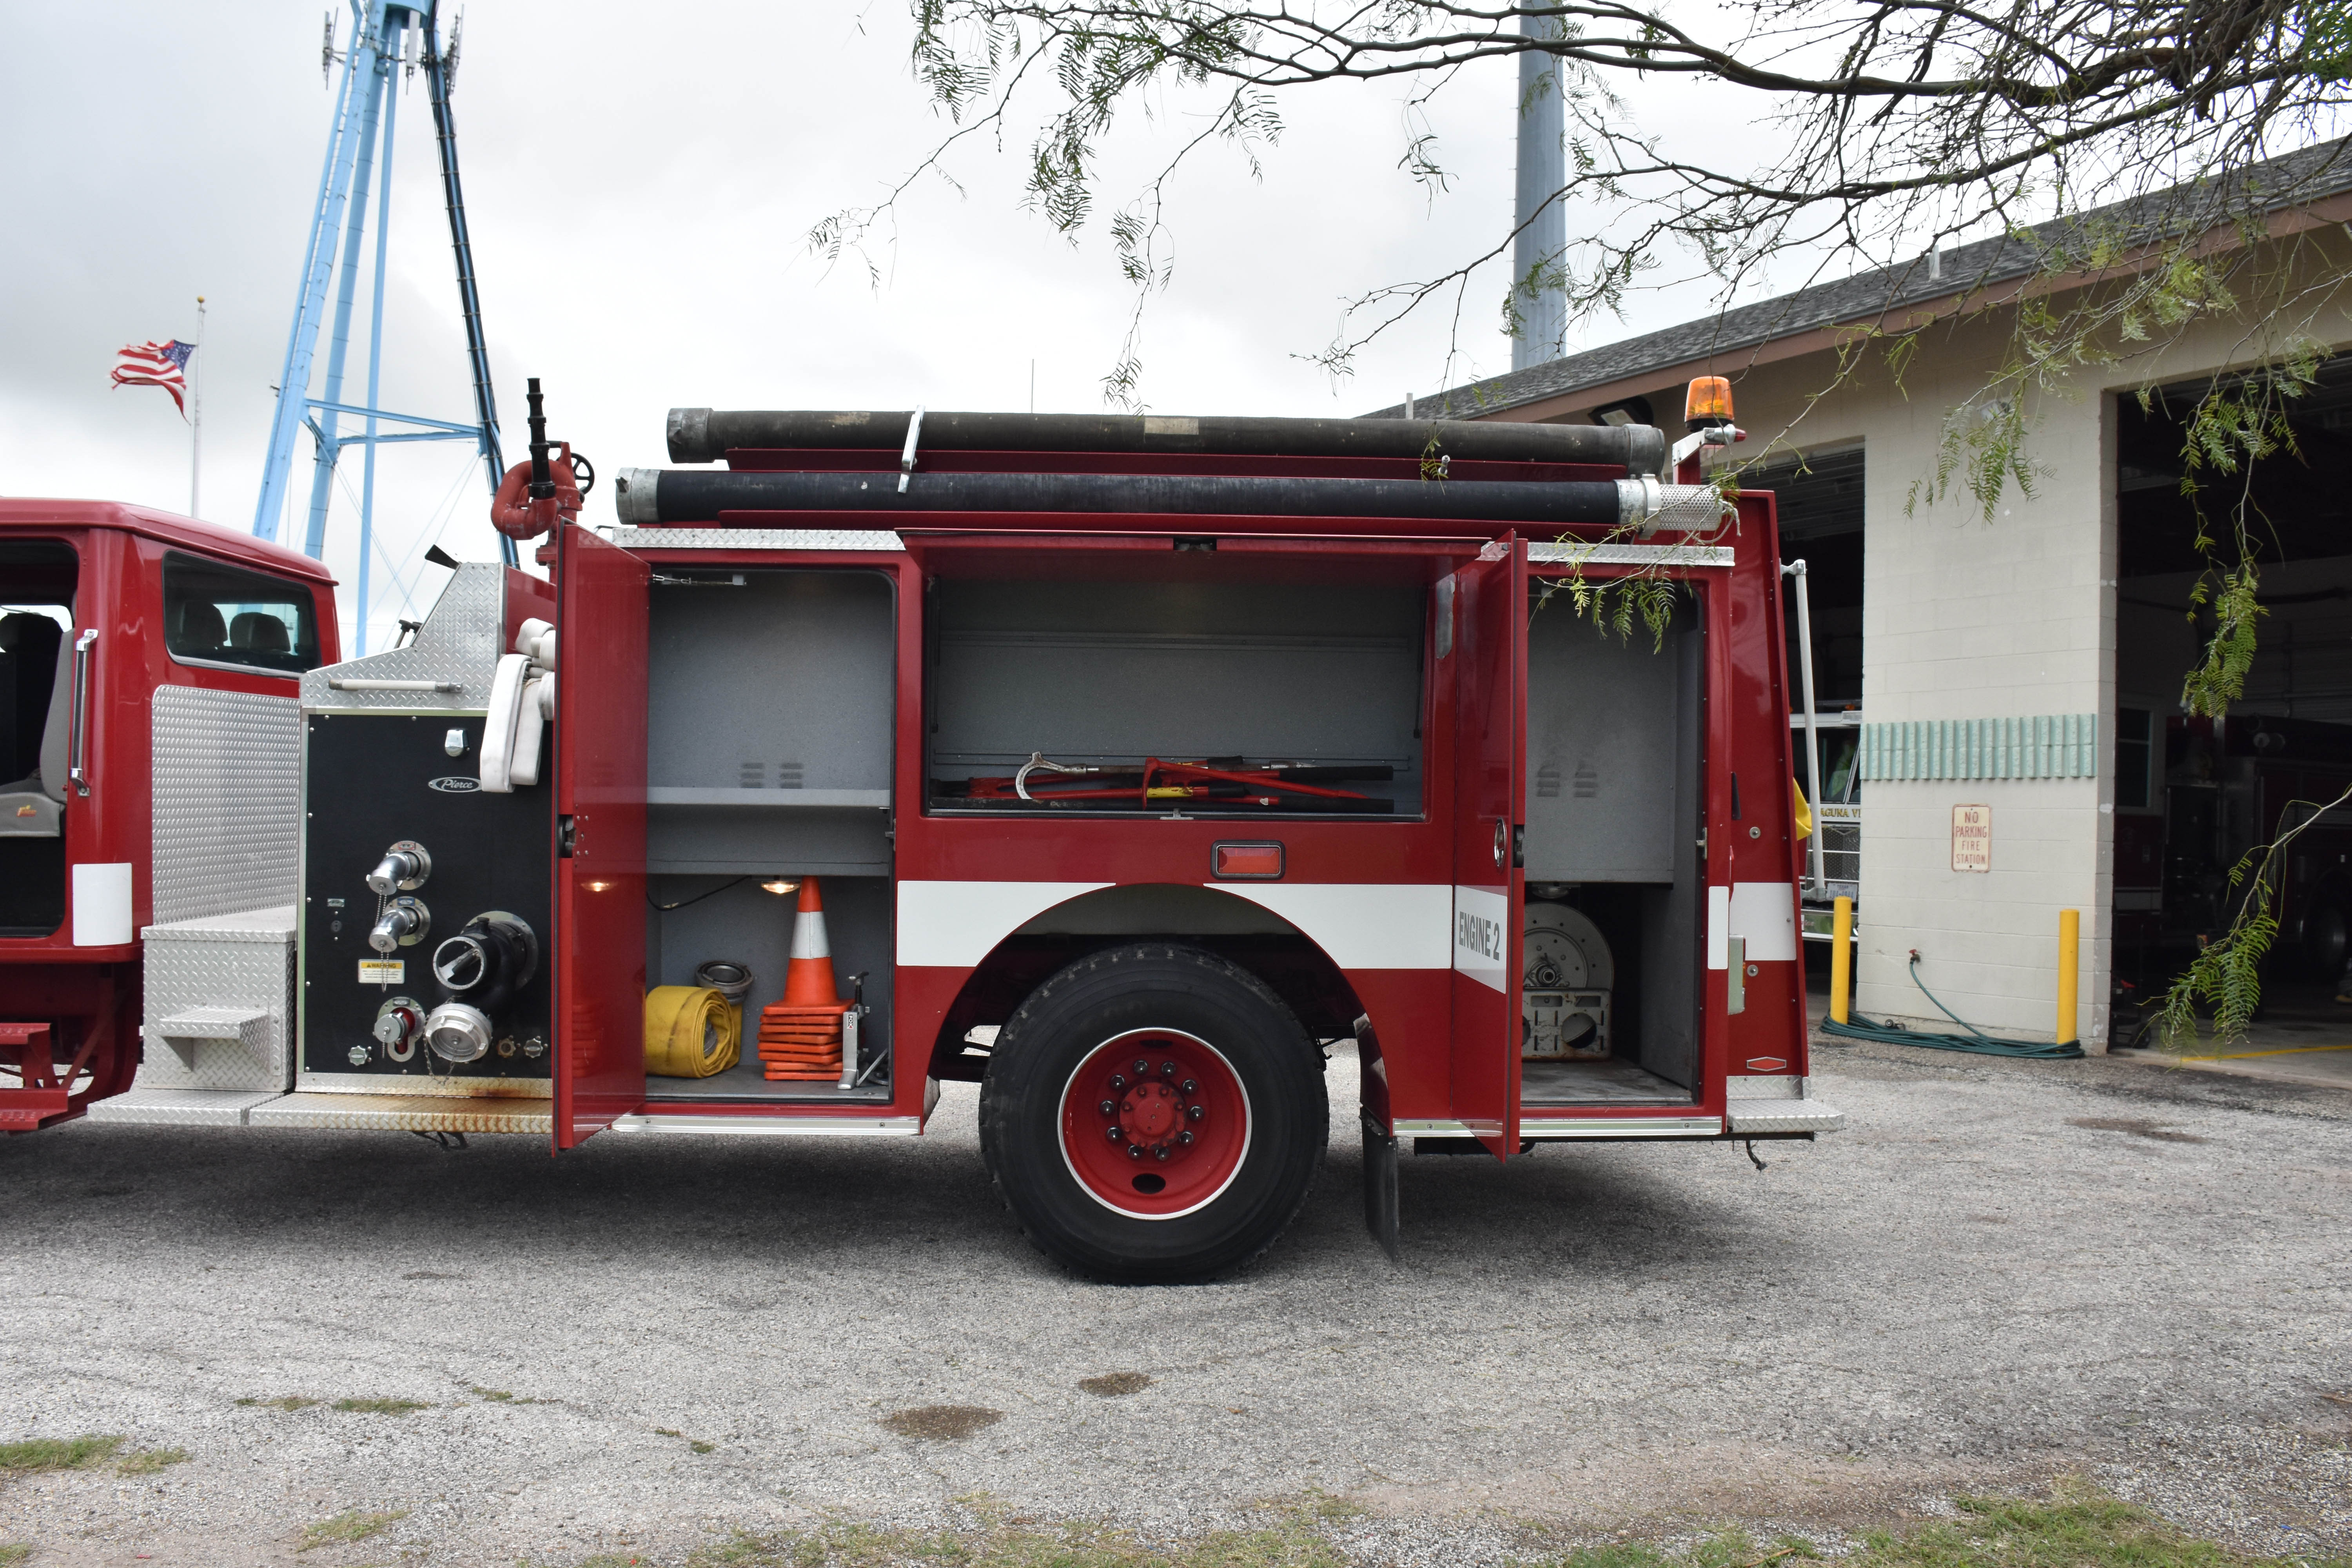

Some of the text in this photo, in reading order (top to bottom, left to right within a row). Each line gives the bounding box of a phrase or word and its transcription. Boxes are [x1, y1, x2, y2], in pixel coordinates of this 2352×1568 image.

[441, 779, 473, 790] Pierce
[1820, 808, 1861, 818] AGUNA VI
[1965, 811, 1978, 824] NO
[1955, 826, 1987, 838] PARKING
[1962, 840, 1980, 851] FIRE
[1956, 854, 1985, 864] STATION
[1459, 911, 1500, 961] ENGINE 2
